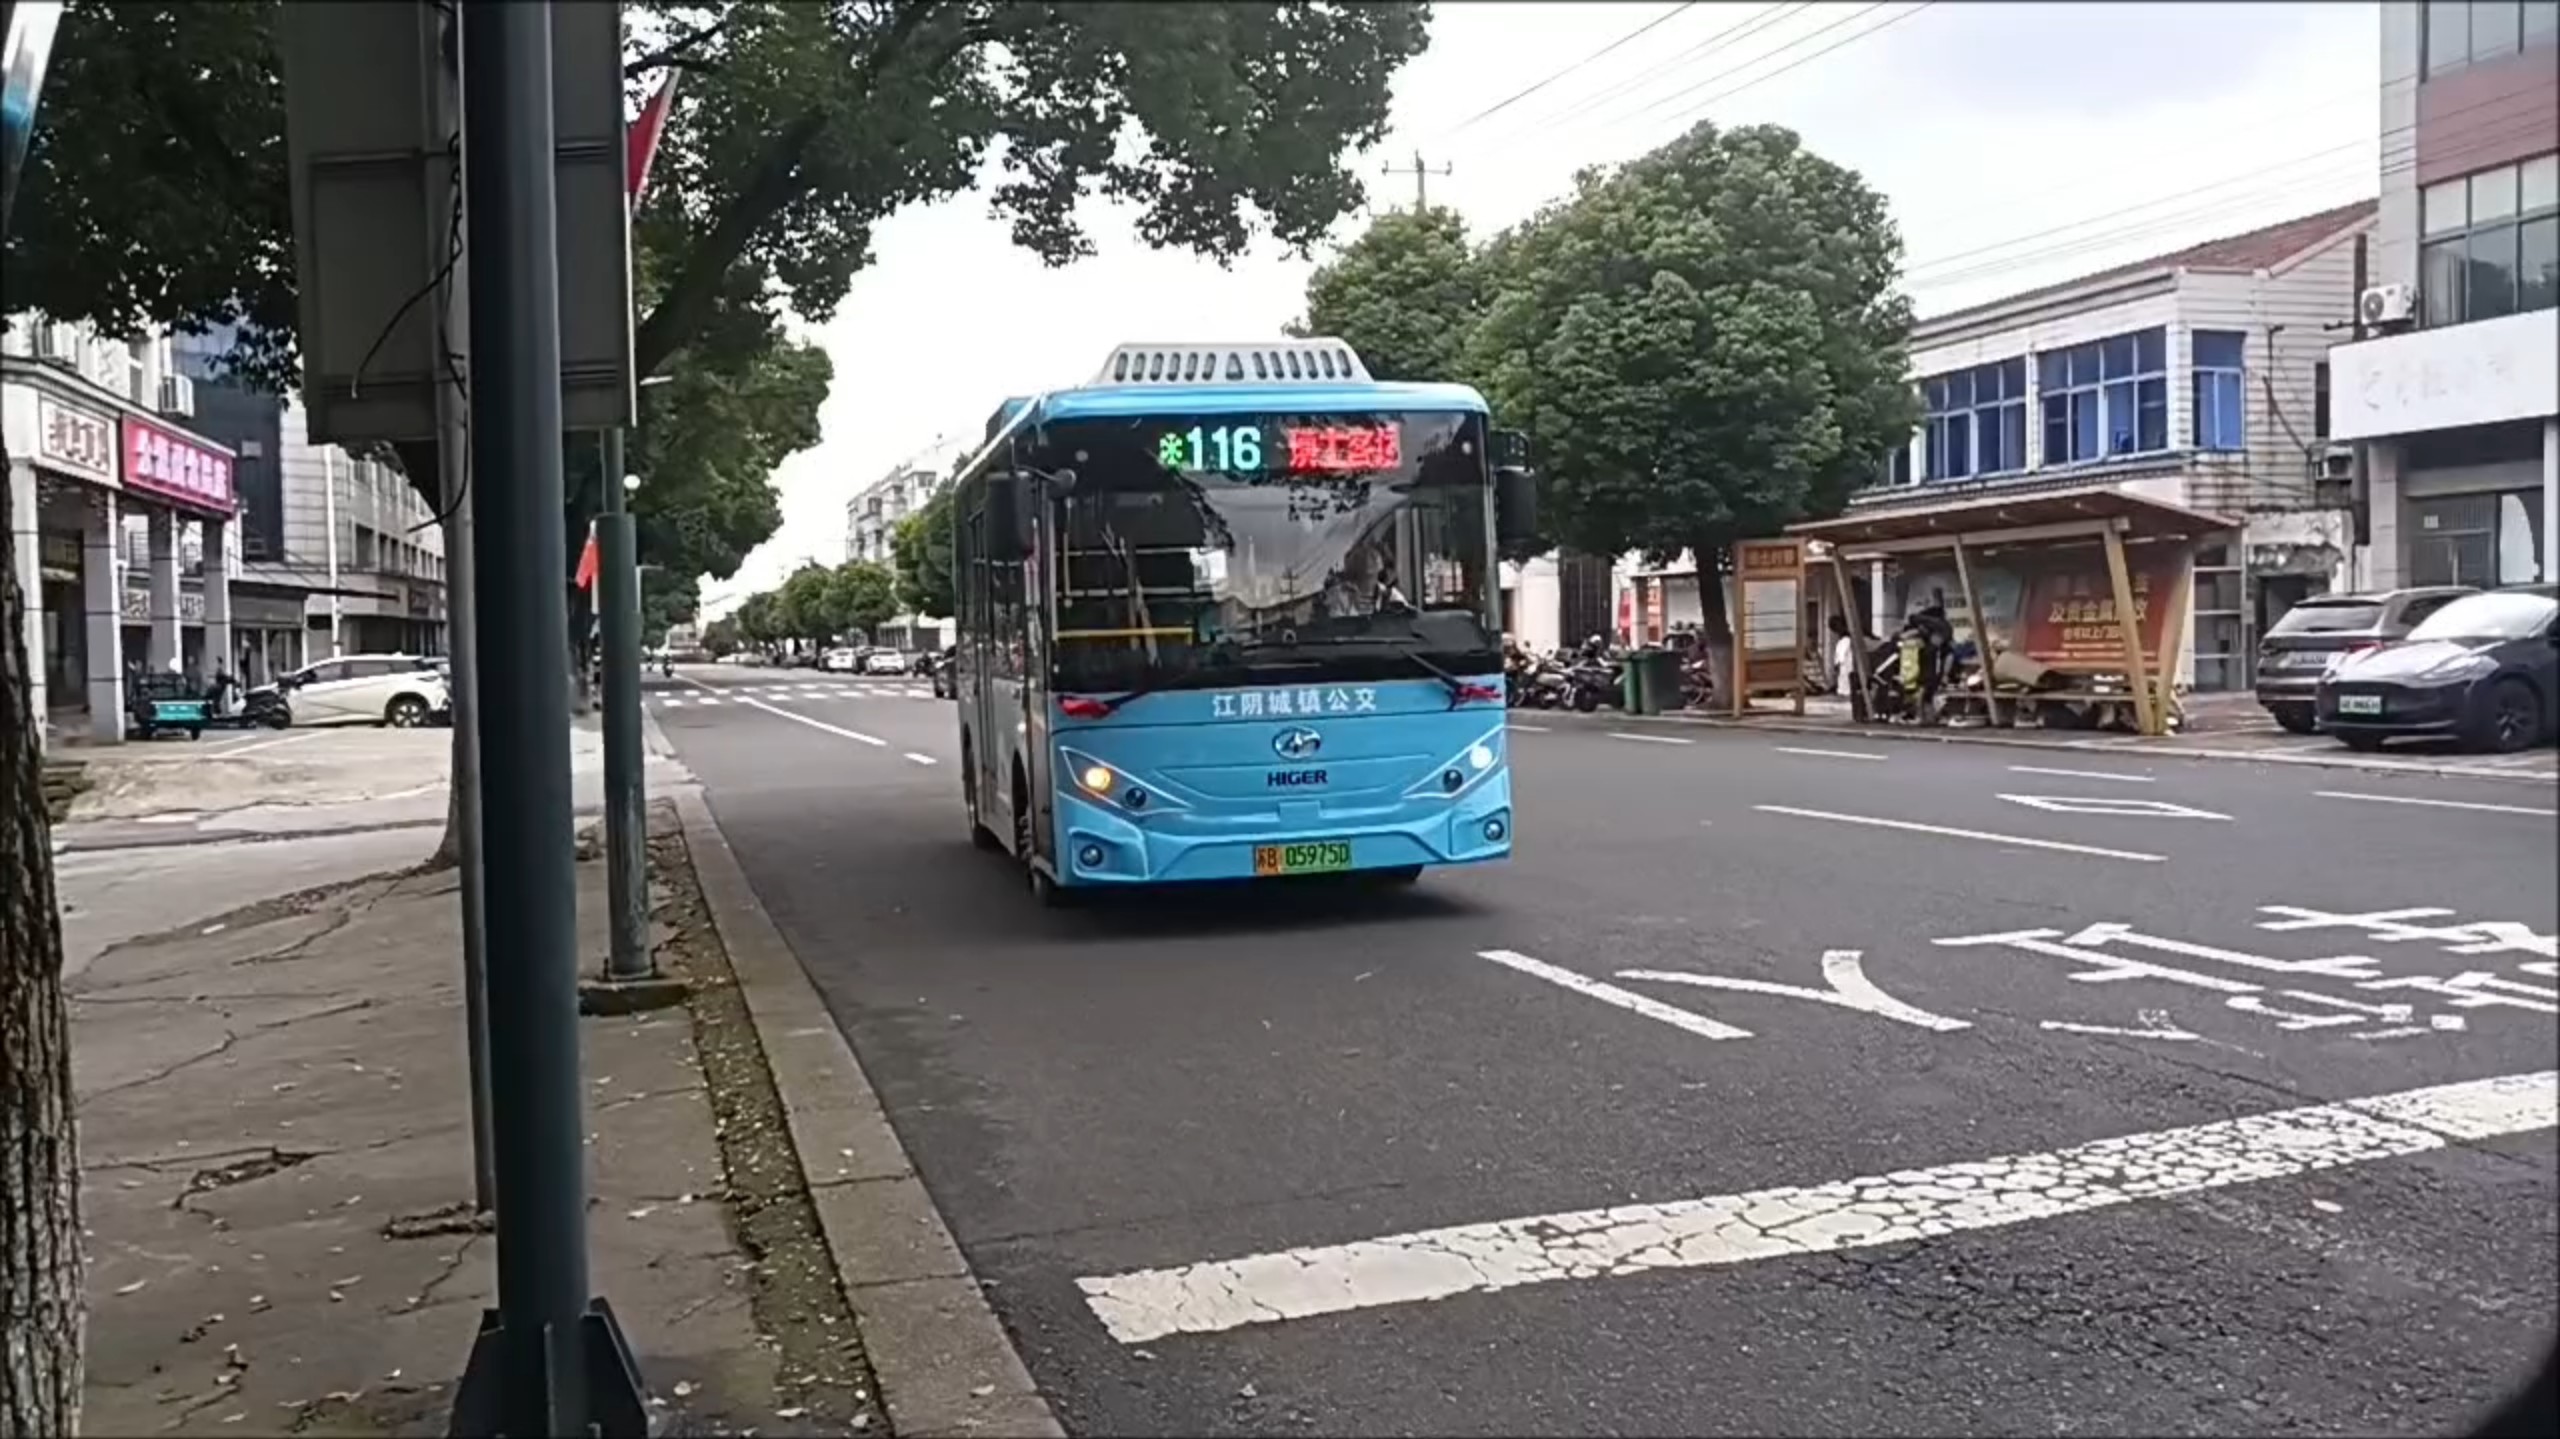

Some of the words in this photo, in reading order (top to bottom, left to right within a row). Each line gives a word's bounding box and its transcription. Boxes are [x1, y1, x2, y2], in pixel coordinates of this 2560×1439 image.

[1186, 425, 1261, 471] 116
[1212, 687, 1377, 717] 江阴城镇公交
[1267, 769, 1328, 787] HIGER
